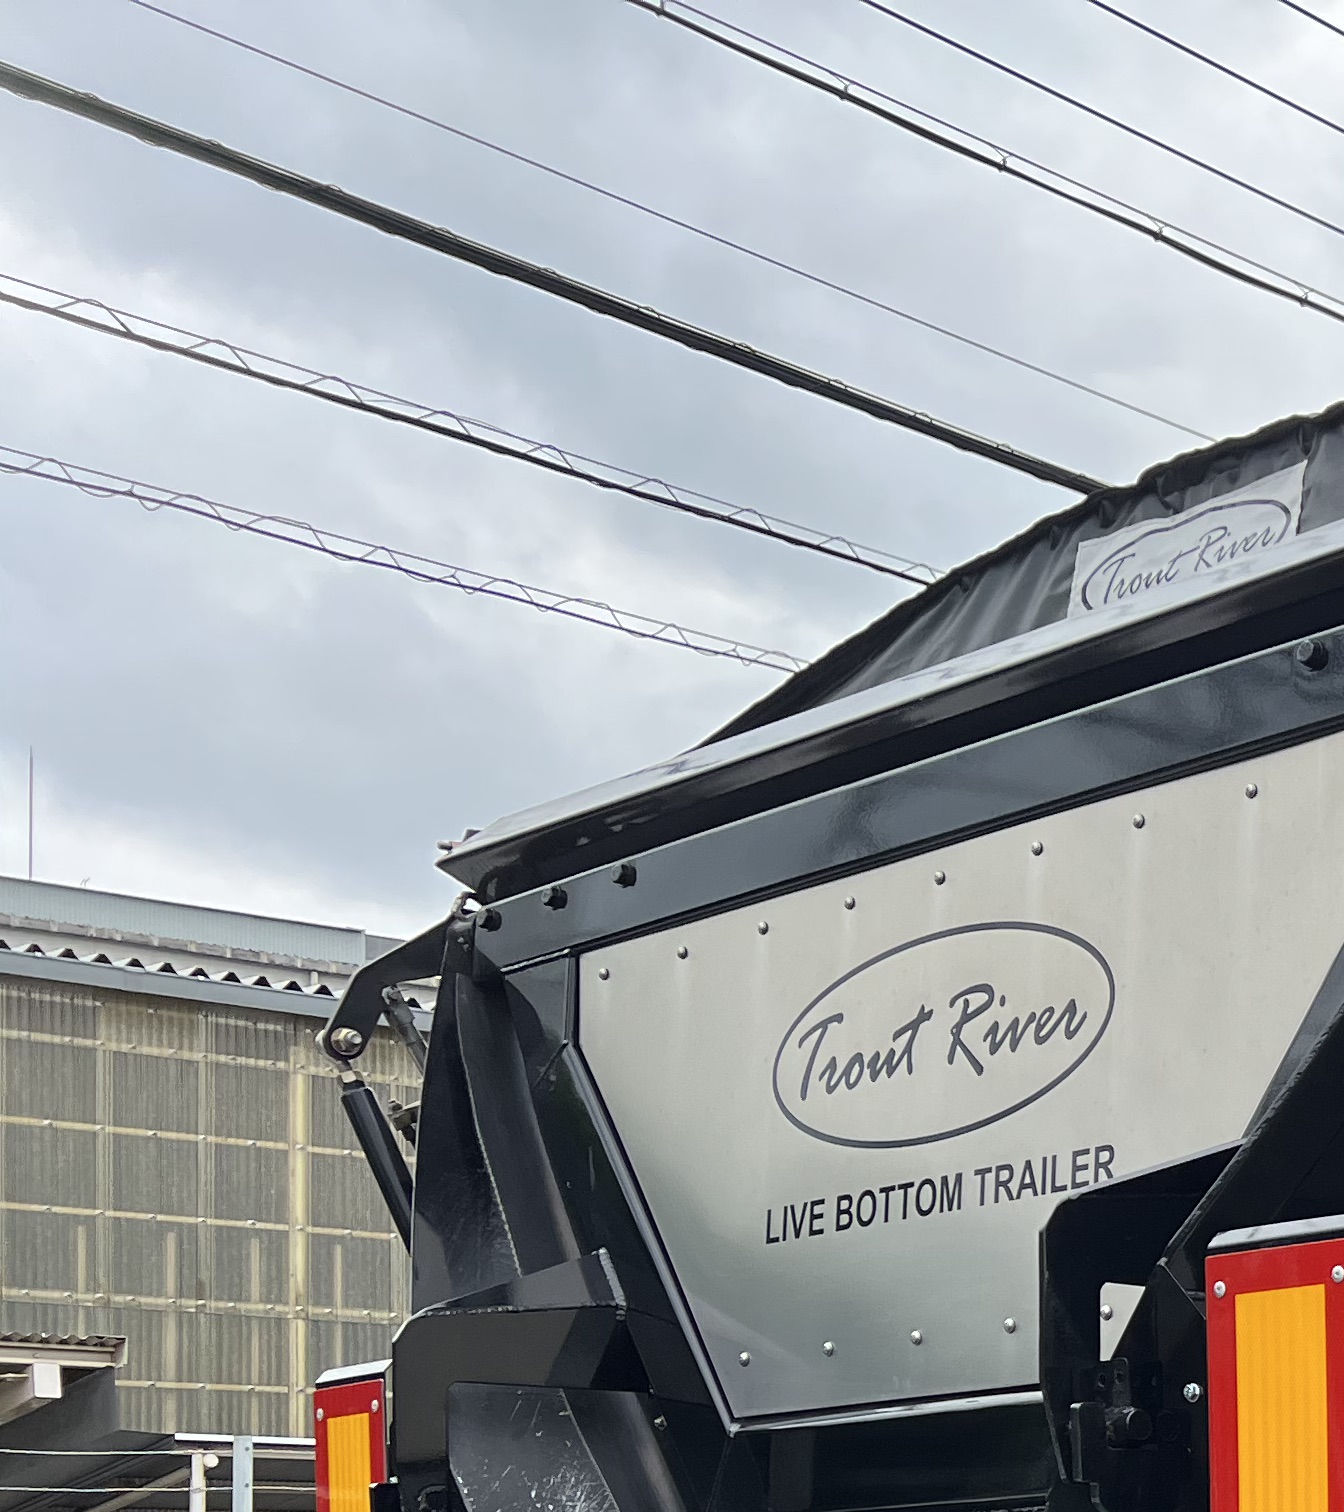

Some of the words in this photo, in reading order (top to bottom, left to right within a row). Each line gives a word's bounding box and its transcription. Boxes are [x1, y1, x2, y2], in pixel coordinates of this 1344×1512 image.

[1102, 547, 1198, 605] Trout
[1194, 525, 1279, 573] River
[797, 1003, 933, 1101] Trout
[947, 982, 1088, 1076] River
[765, 1198, 826, 1245] LIVE
[834, 1172, 963, 1233] BOTTOM
[973, 1144, 1116, 1207] TRAILER
